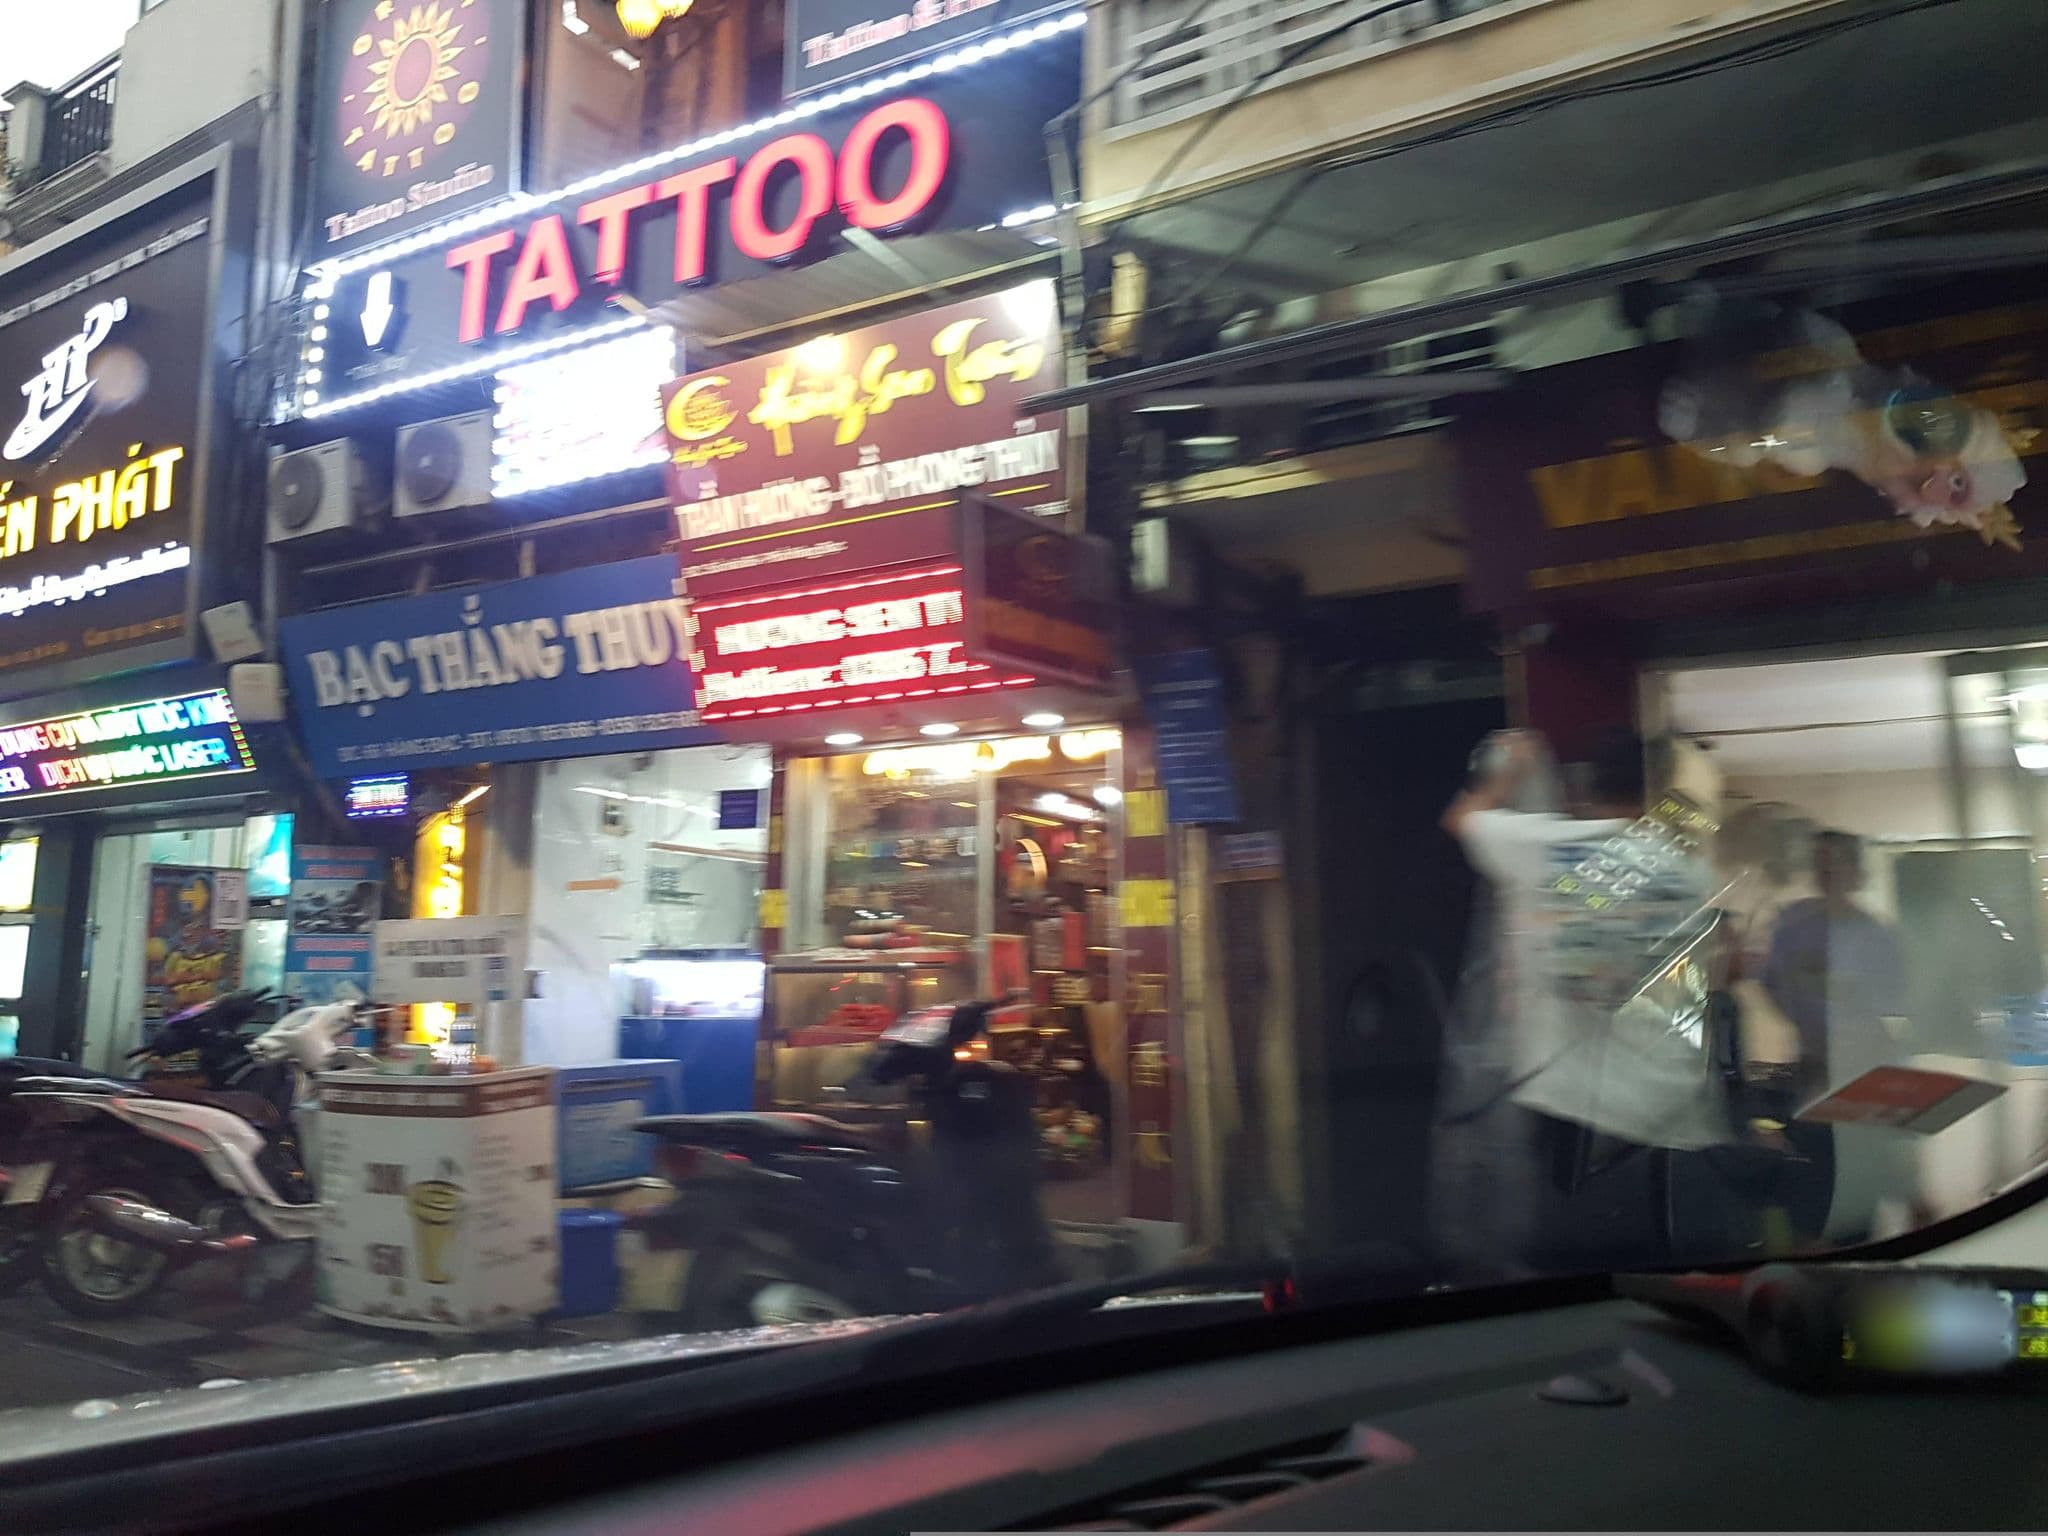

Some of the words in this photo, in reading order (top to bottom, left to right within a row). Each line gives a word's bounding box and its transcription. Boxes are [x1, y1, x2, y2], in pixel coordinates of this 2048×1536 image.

[446, 98, 950, 344] TATTOO
[50, 441, 184, 543] PHÁT
[306, 640, 411, 718] BẠC
[407, 593, 566, 696] THẮNG
